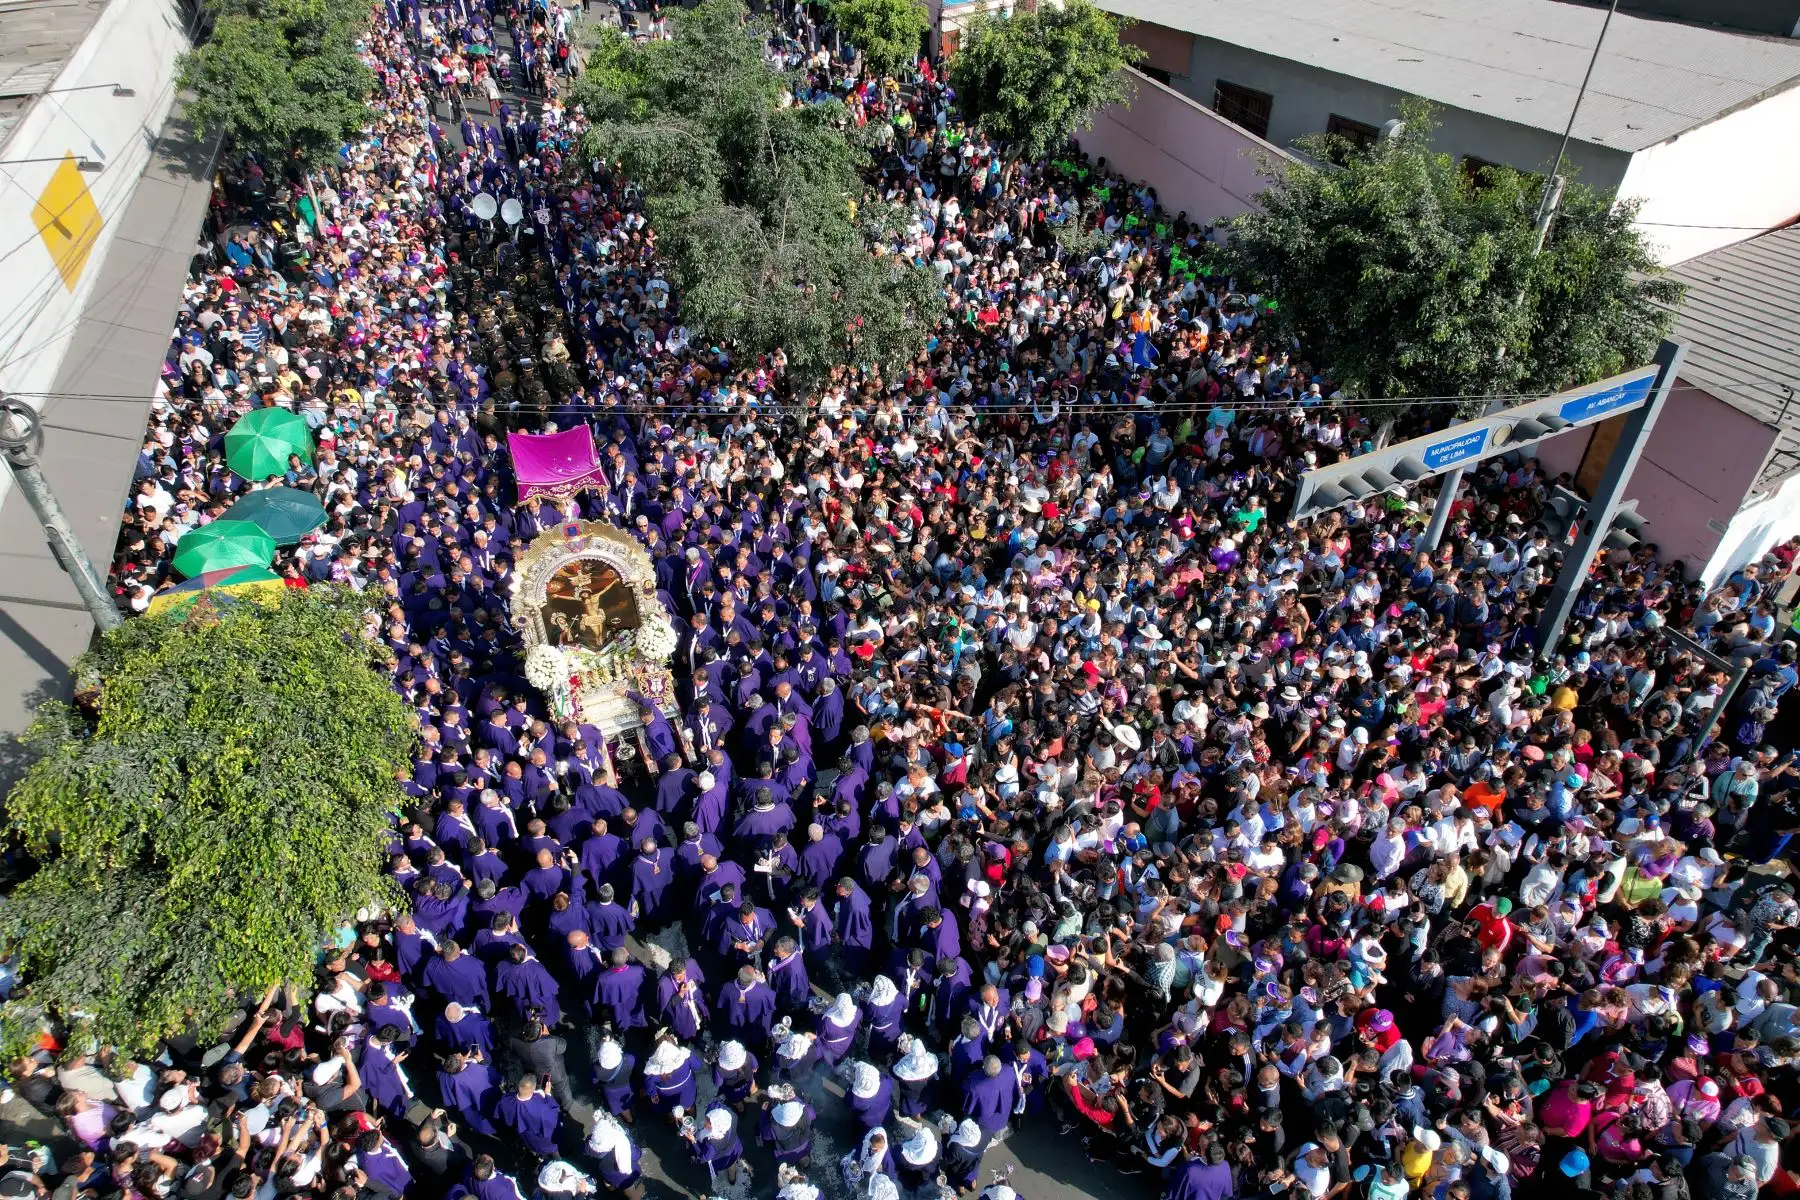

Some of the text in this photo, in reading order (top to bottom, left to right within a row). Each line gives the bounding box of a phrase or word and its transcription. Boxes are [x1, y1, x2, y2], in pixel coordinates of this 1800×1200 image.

[1597, 392, 1627, 407] ABANCAY
[1431, 436, 1480, 456] MUNICIPALIDAD
[1440, 449, 1465, 462] DE LIMA
